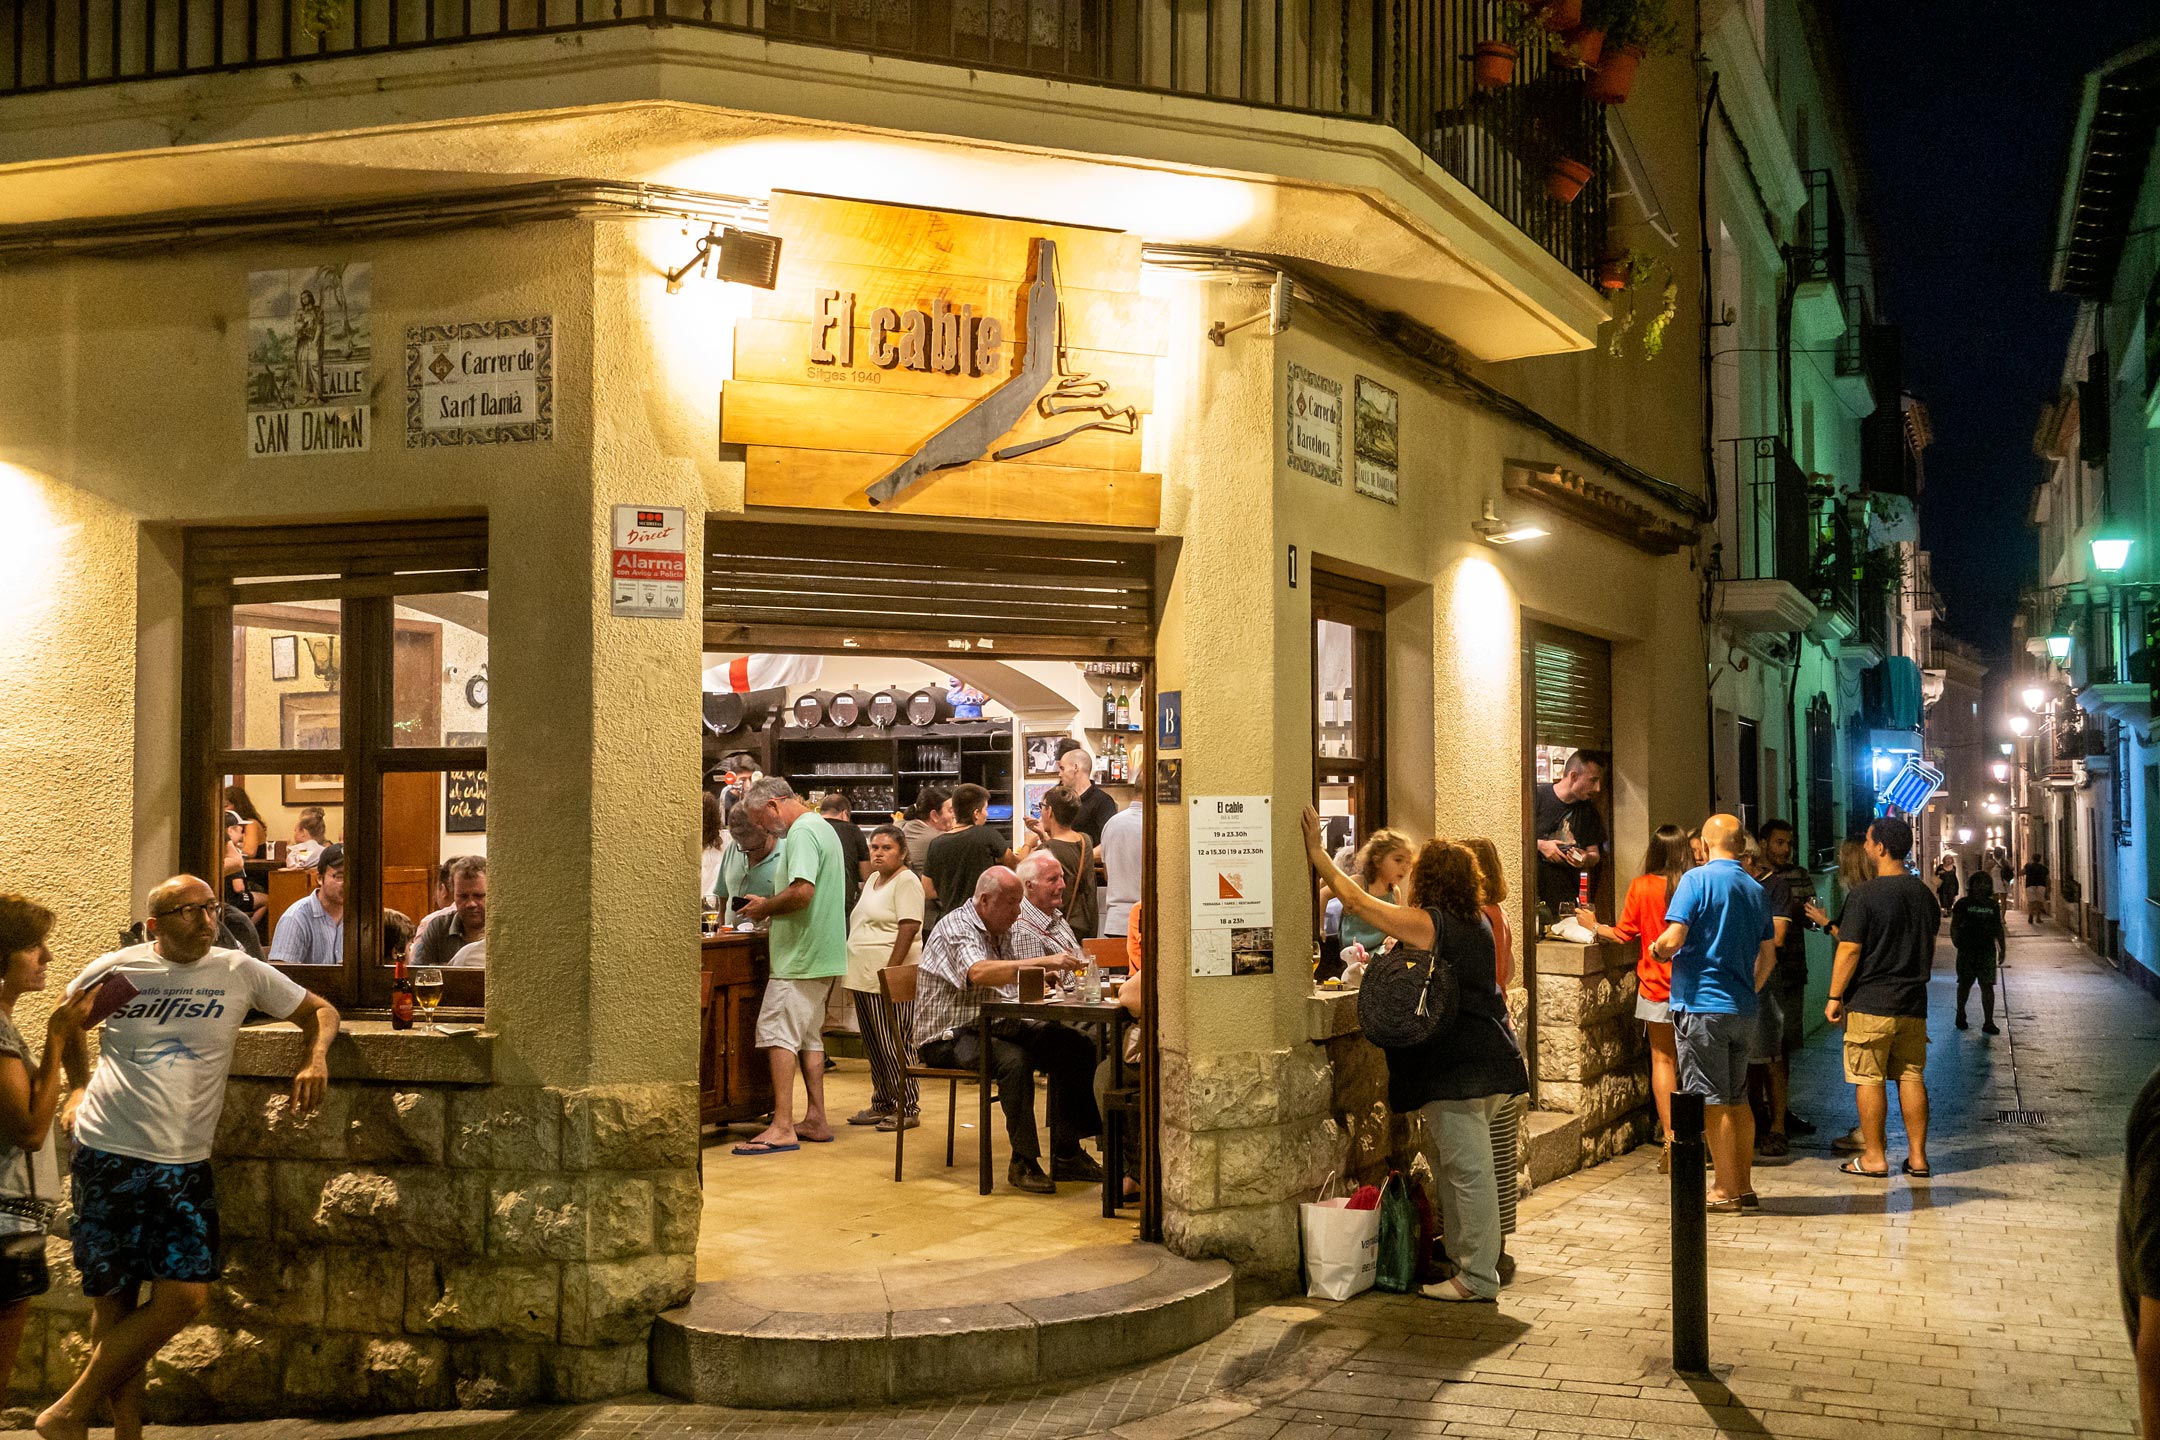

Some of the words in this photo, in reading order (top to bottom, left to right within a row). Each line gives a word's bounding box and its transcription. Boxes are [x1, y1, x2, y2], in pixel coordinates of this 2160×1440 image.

[810, 287, 856, 367] El
[869, 298, 1002, 377] cable
[462, 351, 518, 375] Carrer
[519, 347, 535, 372] de
[322, 371, 362, 395] CALLE
[807, 366, 848, 381] Sitges
[852, 371, 880, 384] 1940
[440, 394, 477, 419] Sant
[480, 390, 522, 415] Damià
[255, 415, 289, 453] SAN
[302, 408, 362, 450] DAMIAN
[1297, 425, 1330, 458] Barcelona
[627, 528, 674, 544] Direct
[617, 554, 683, 570] Alarma
[1290, 550, 1296, 582] 1
[1166, 707, 1174, 733] B
[1217, 801, 1223, 813] El
[1225, 801, 1243, 813] cable
[163, 987, 192, 998] sprint
[196, 987, 225, 997] sitges
[113, 998, 224, 1024] sailfish
